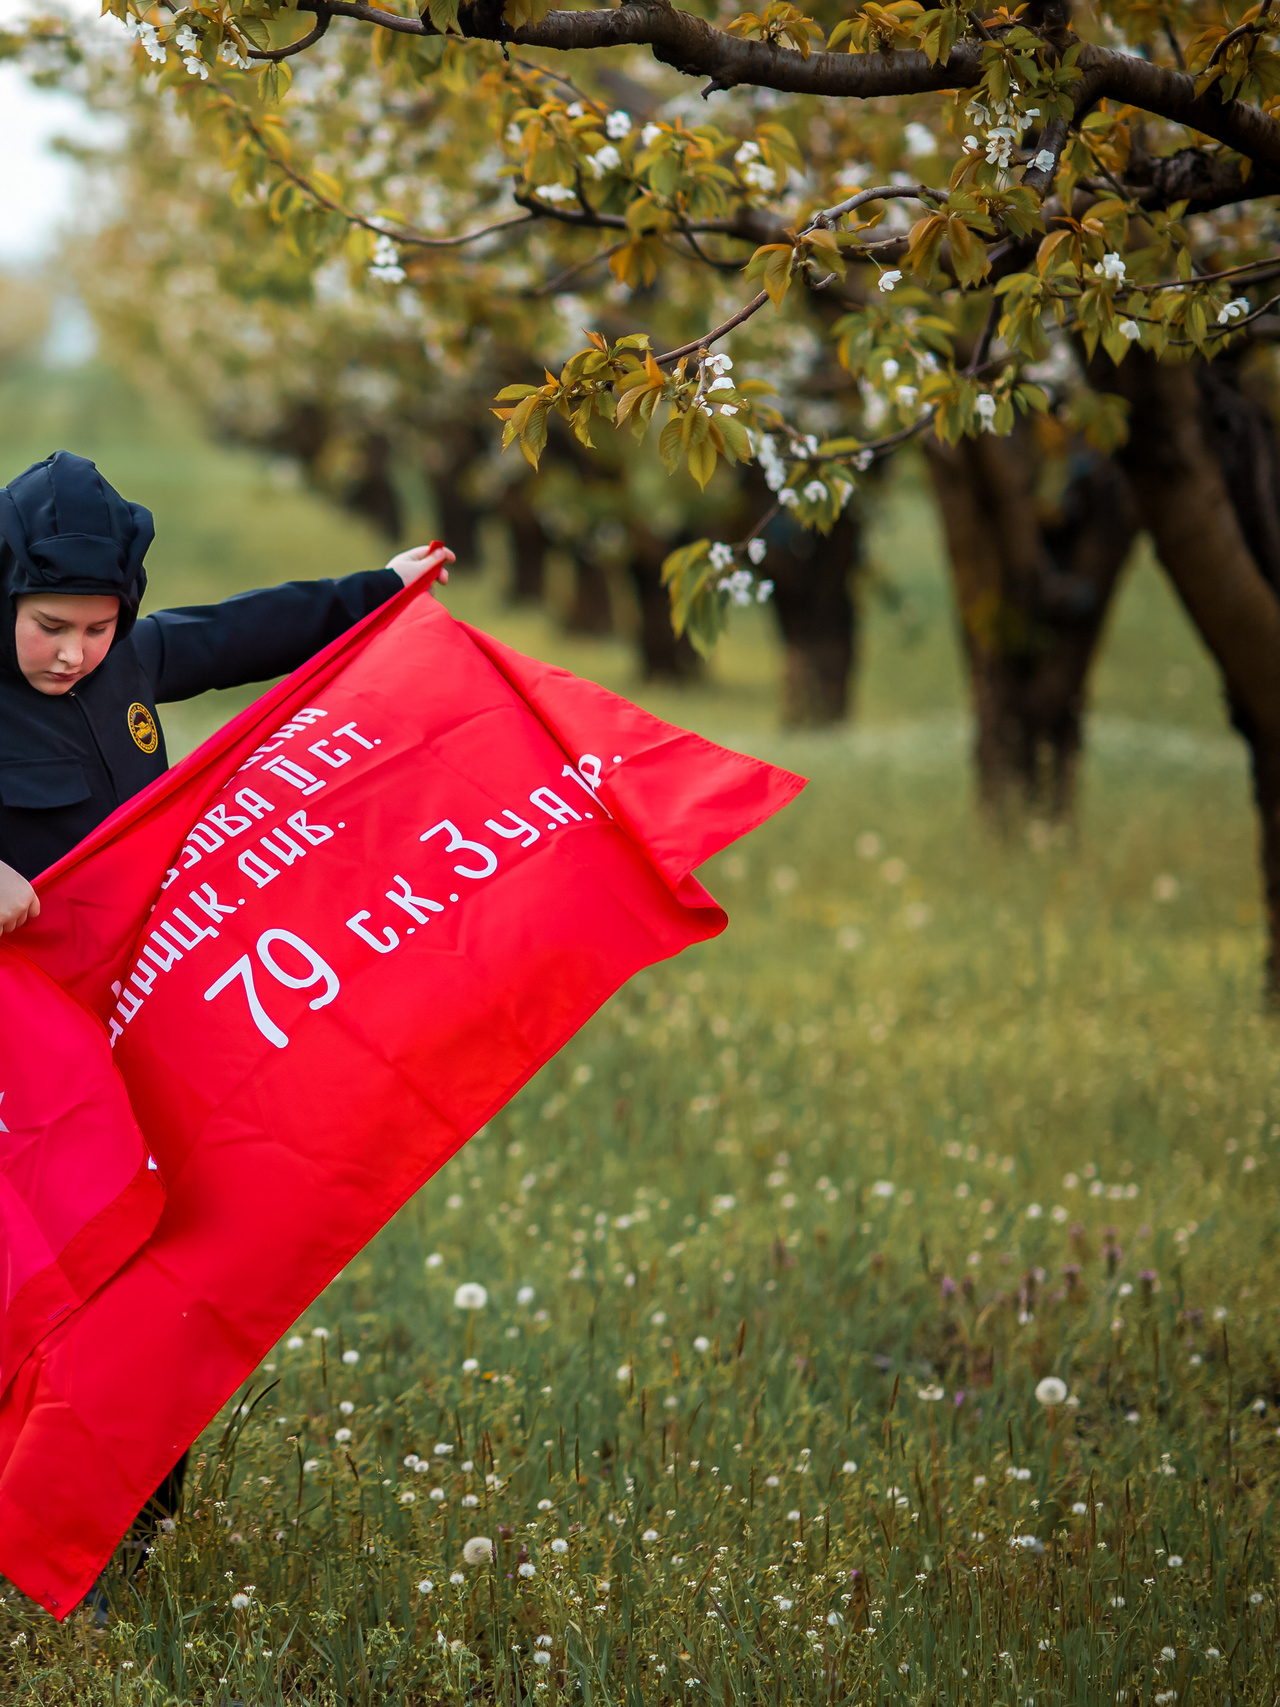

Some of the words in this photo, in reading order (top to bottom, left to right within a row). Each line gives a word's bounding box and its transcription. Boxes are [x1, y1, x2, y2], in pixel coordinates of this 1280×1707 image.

[150, 787, 276, 912] ЗОВА
[307, 721, 382, 769] СТ.
[237, 809, 346, 889] ДИВ.
[203, 928, 341, 1049] 79
[345, 874, 459, 954] С.К.
